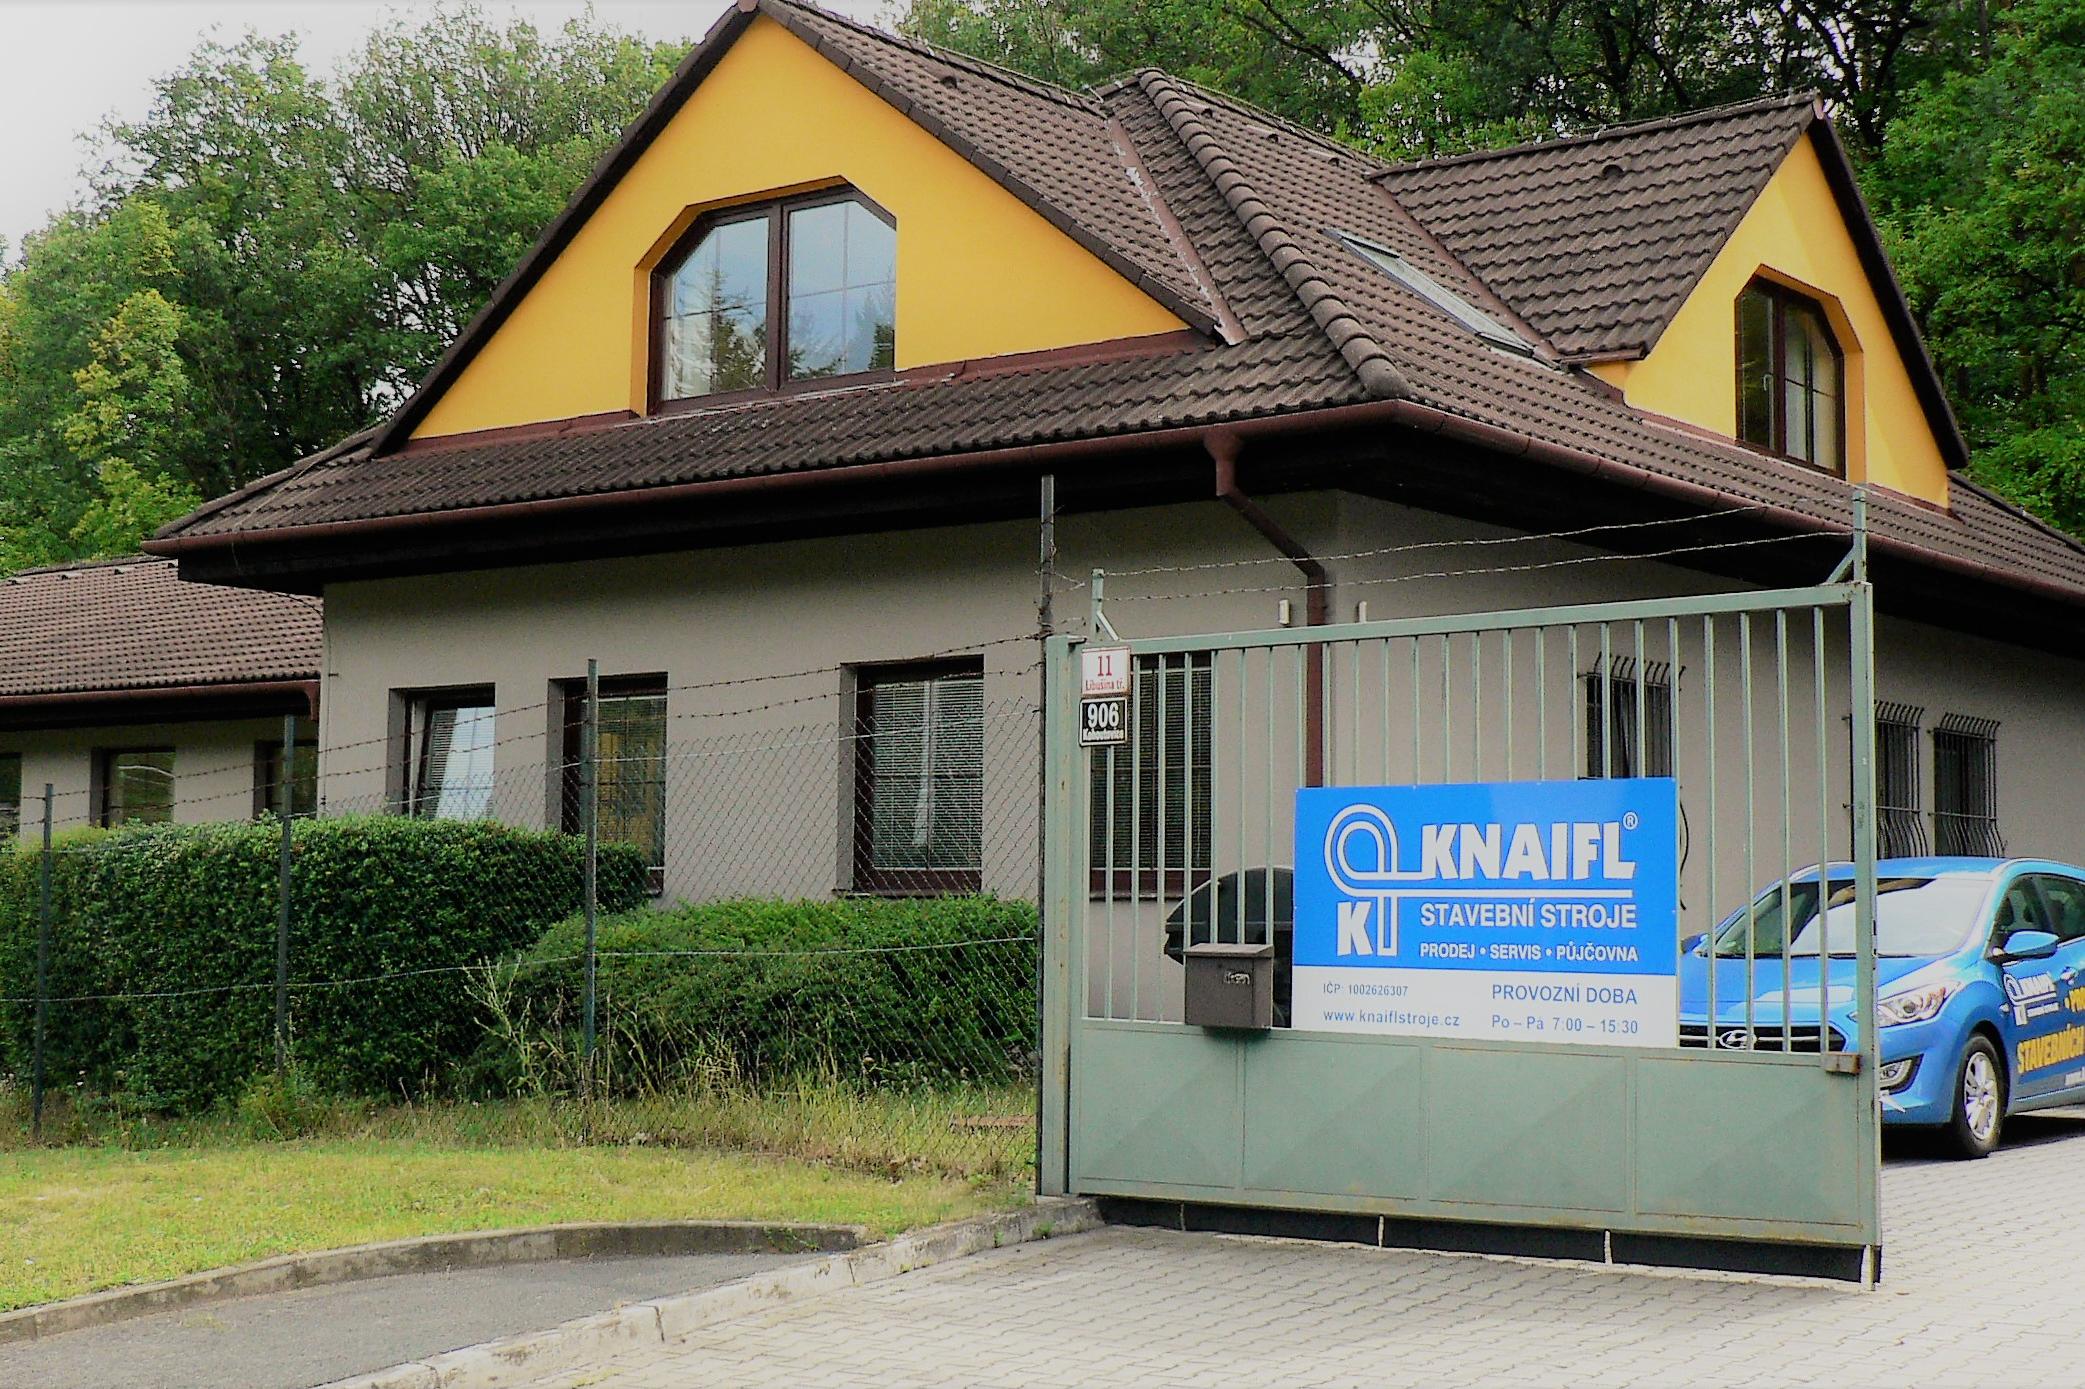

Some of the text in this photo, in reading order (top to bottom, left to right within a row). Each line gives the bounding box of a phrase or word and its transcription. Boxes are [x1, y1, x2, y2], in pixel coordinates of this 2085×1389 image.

[1097, 655, 1113, 677] 11
[1087, 702, 1120, 728] 906
[1420, 897, 1638, 928] STAVEBNÍ STROJE
[1419, 940, 1639, 962] PRODEJ SERVIS PŮJČOVNA
[1348, 984, 1409, 997] 1002626307
[1491, 983, 1638, 1005] PROVOZNÍ DOBA
[1323, 1009, 1461, 1028] www.knaiflstroje.cz
[1491, 1014, 1510, 1029] Po
[1552, 1017, 1582, 1032] 7:00
[1600, 1019, 1638, 1034] 15:30
